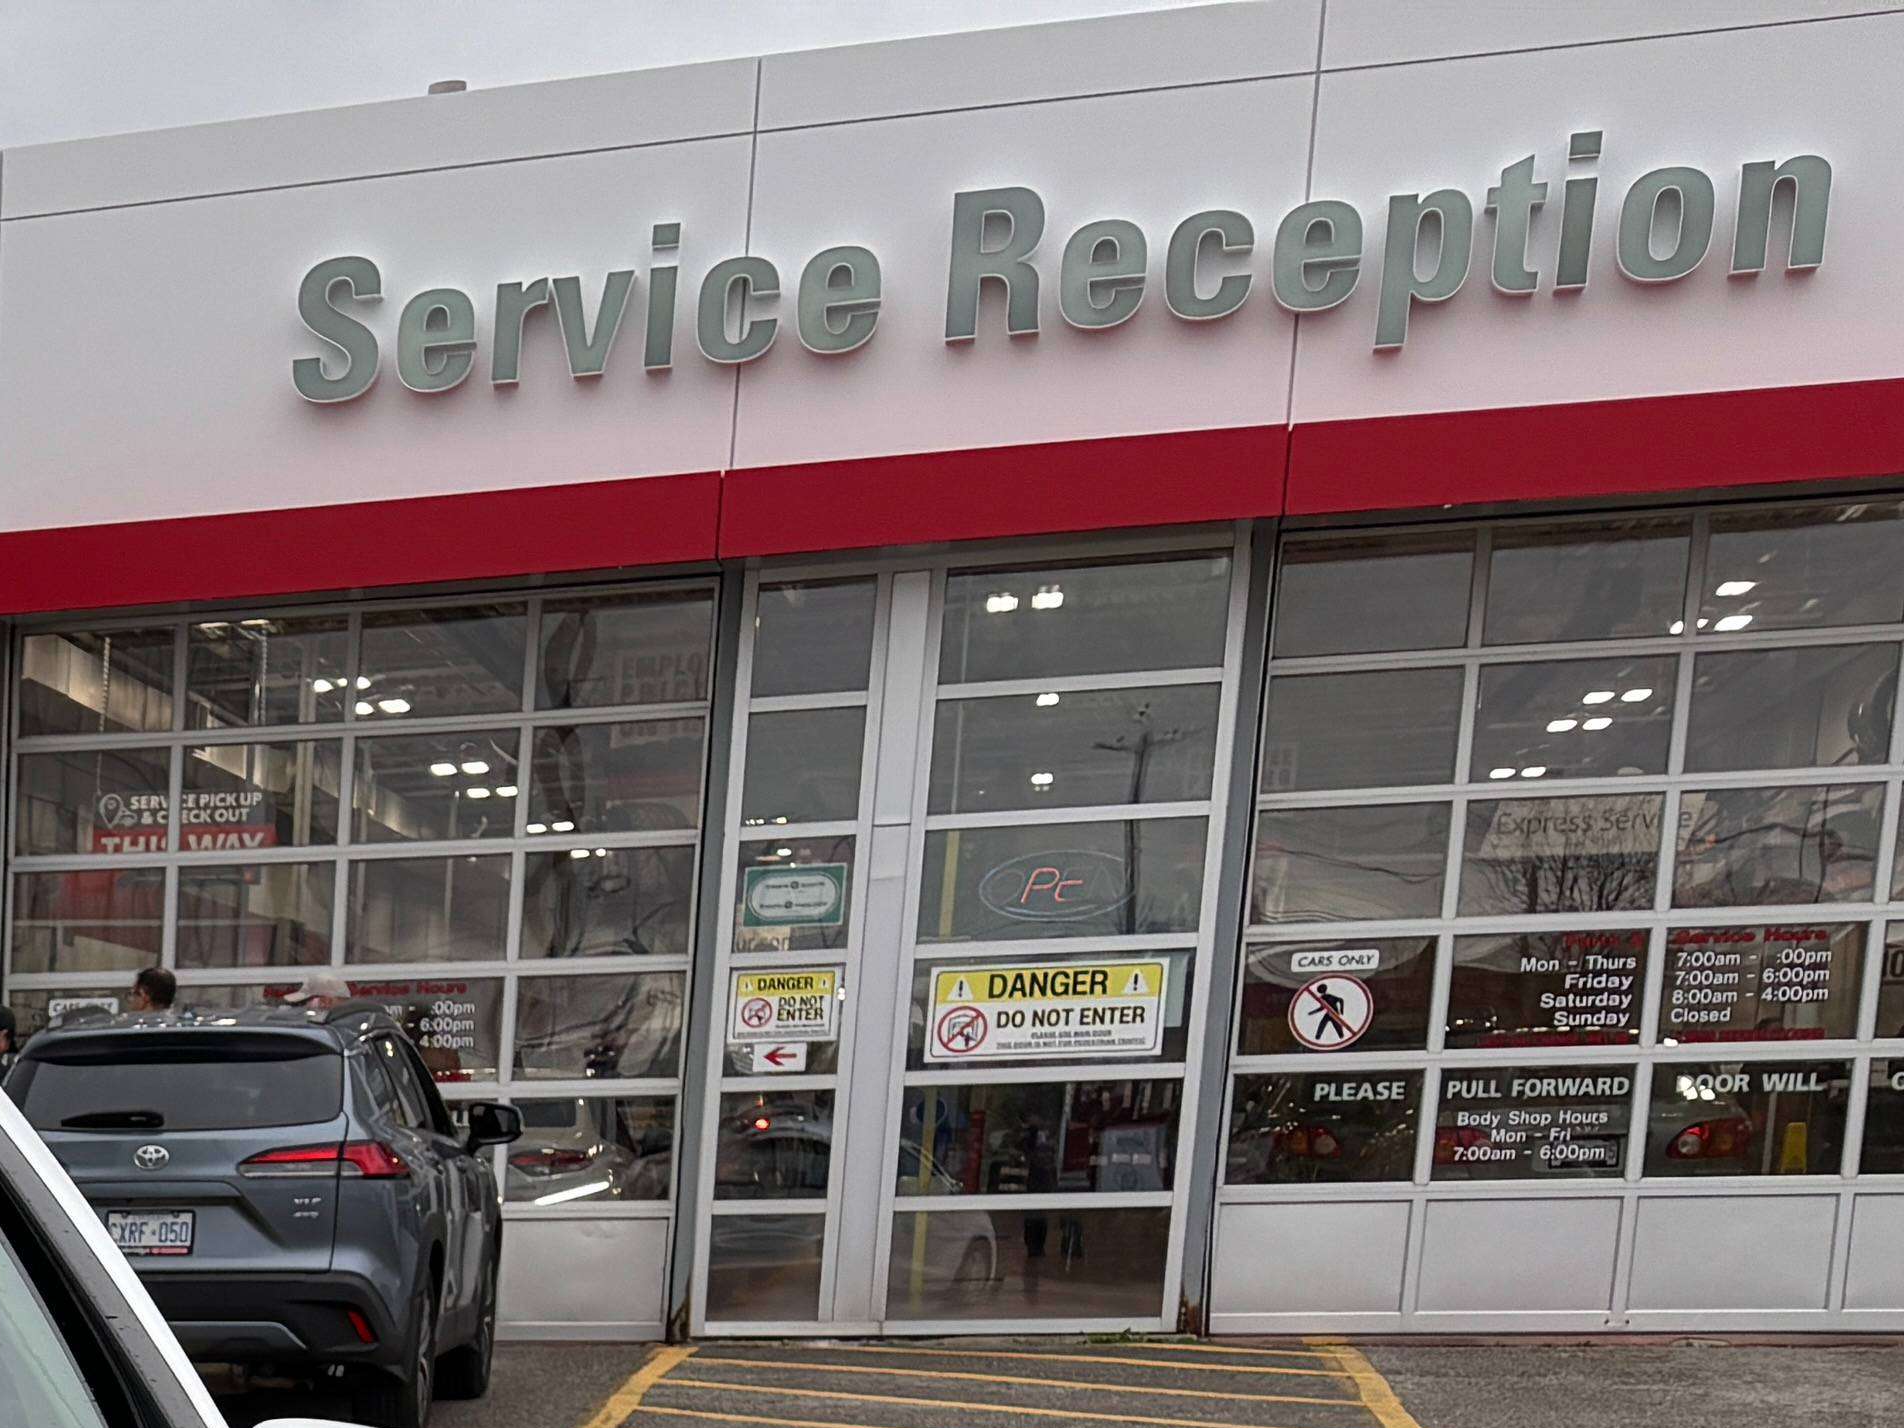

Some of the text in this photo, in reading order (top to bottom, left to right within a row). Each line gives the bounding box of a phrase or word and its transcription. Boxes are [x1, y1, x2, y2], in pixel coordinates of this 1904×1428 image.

[292, 130, 1834, 404] Service Reception
[130, 792, 263, 810] SERVCE PICK UP
[141, 808, 250, 824] & CECK OUT
[1496, 809, 1692, 838] Express Serve
[1298, 953, 1375, 968] CARS ONLY
[1520, 958, 1559, 973] Mon
[1585, 955, 1637, 970] Thurs
[1677, 951, 1741, 967] 7:00am
[758, 977, 813, 991] DANGER
[988, 970, 1109, 999] DANGER
[1564, 974, 1634, 991] Friday
[1675, 969, 1739, 986] 7:00am
[1762, 967, 1830, 985] 6:00pm
[779, 996, 824, 1009] DO NOT
[1540, 992, 1633, 1010] Saturday
[1672, 988, 1738, 1004] 8:00am
[1761, 986, 1829, 1004] 4:00pm
[777, 1008, 824, 1021] ENTER
[997, 1006, 1145, 1028] DO NOT ENTER
[1553, 1007, 1731, 1027] Sunday Closed
[420, 1018, 474, 1033] 6:00pm
[419, 1034, 474, 1049] 4:00pm
[1314, 1082, 1406, 1101] PLEASE
[1446, 1080, 1502, 1099] PULL
[1511, 1077, 1630, 1098] FORWARD
[1762, 1072, 1824, 1092] WILL
[1456, 1109, 1608, 1127] Body Shop Hours
[1491, 1129, 1526, 1143] Mon
[1549, 1128, 1571, 1142] Fri
[1453, 1147, 1516, 1161] 7:00am
[1540, 1145, 1605, 1162] 6:00pm
